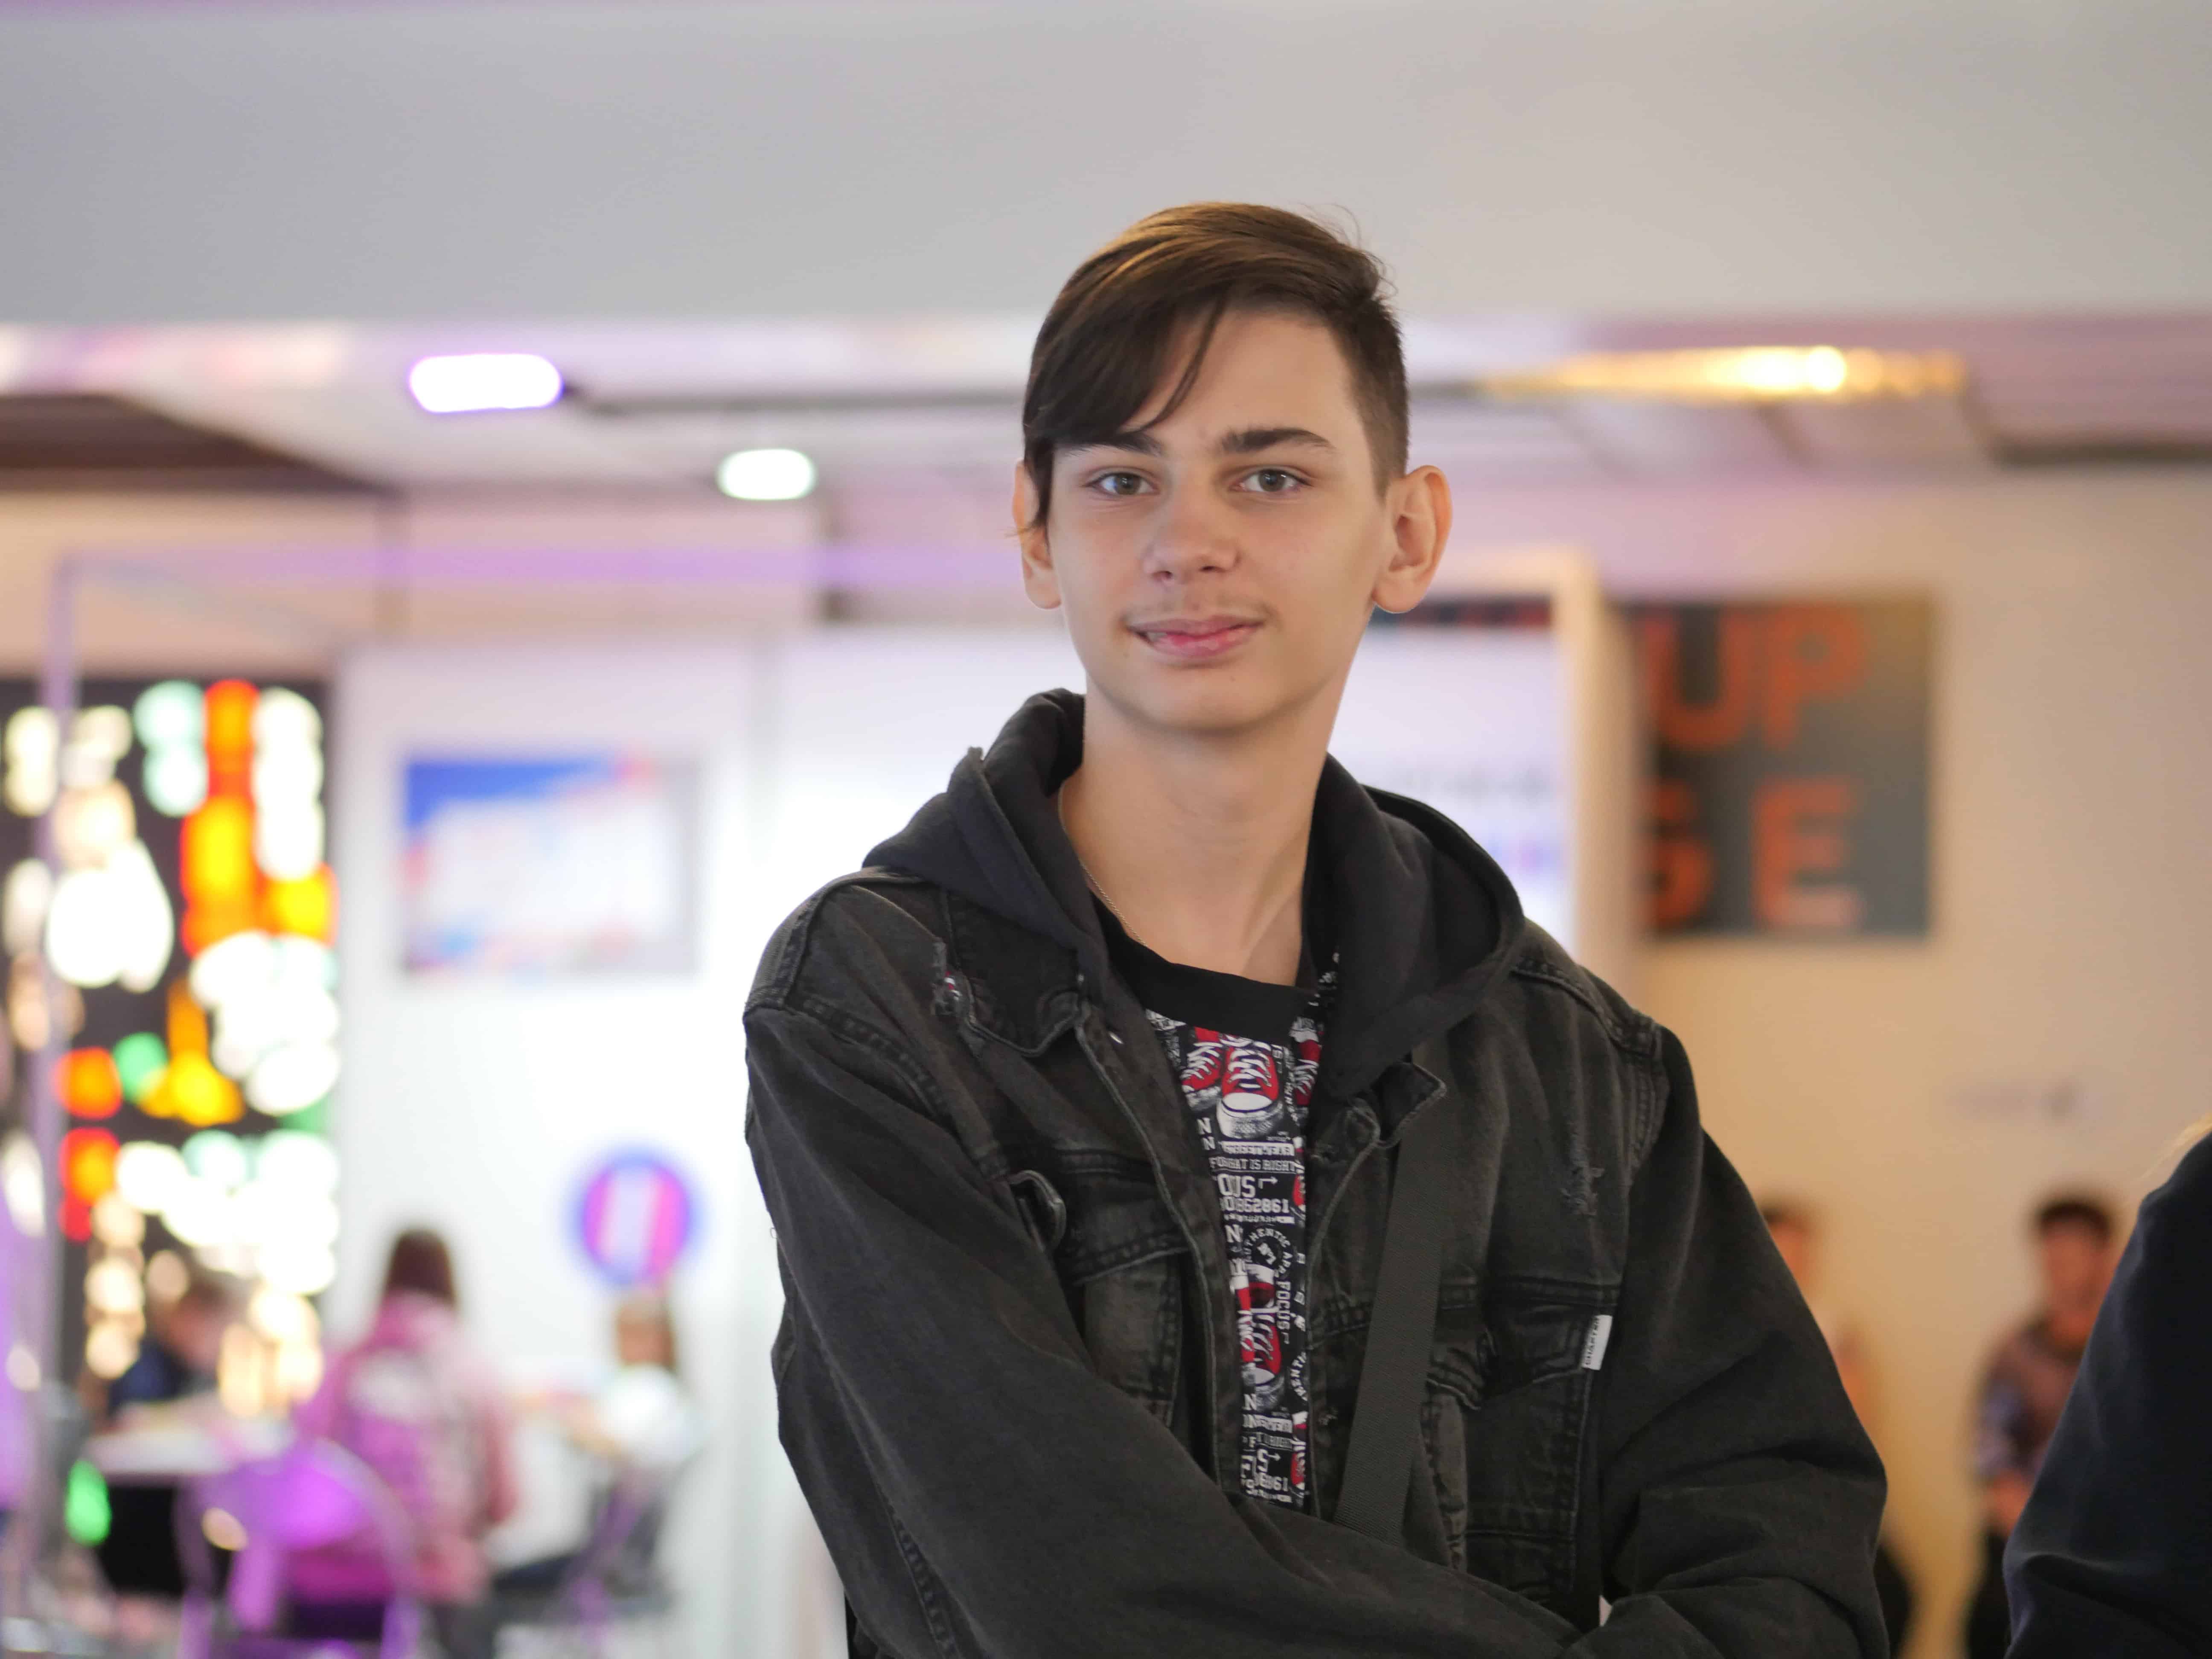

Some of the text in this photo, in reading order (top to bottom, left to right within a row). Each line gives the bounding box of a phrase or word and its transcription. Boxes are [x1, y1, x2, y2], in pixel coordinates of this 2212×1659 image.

[1641, 608, 1869, 747] UP
[1249, 1159, 1261, 1170] IS
[1275, 1281, 1291, 1330] FOCUS
